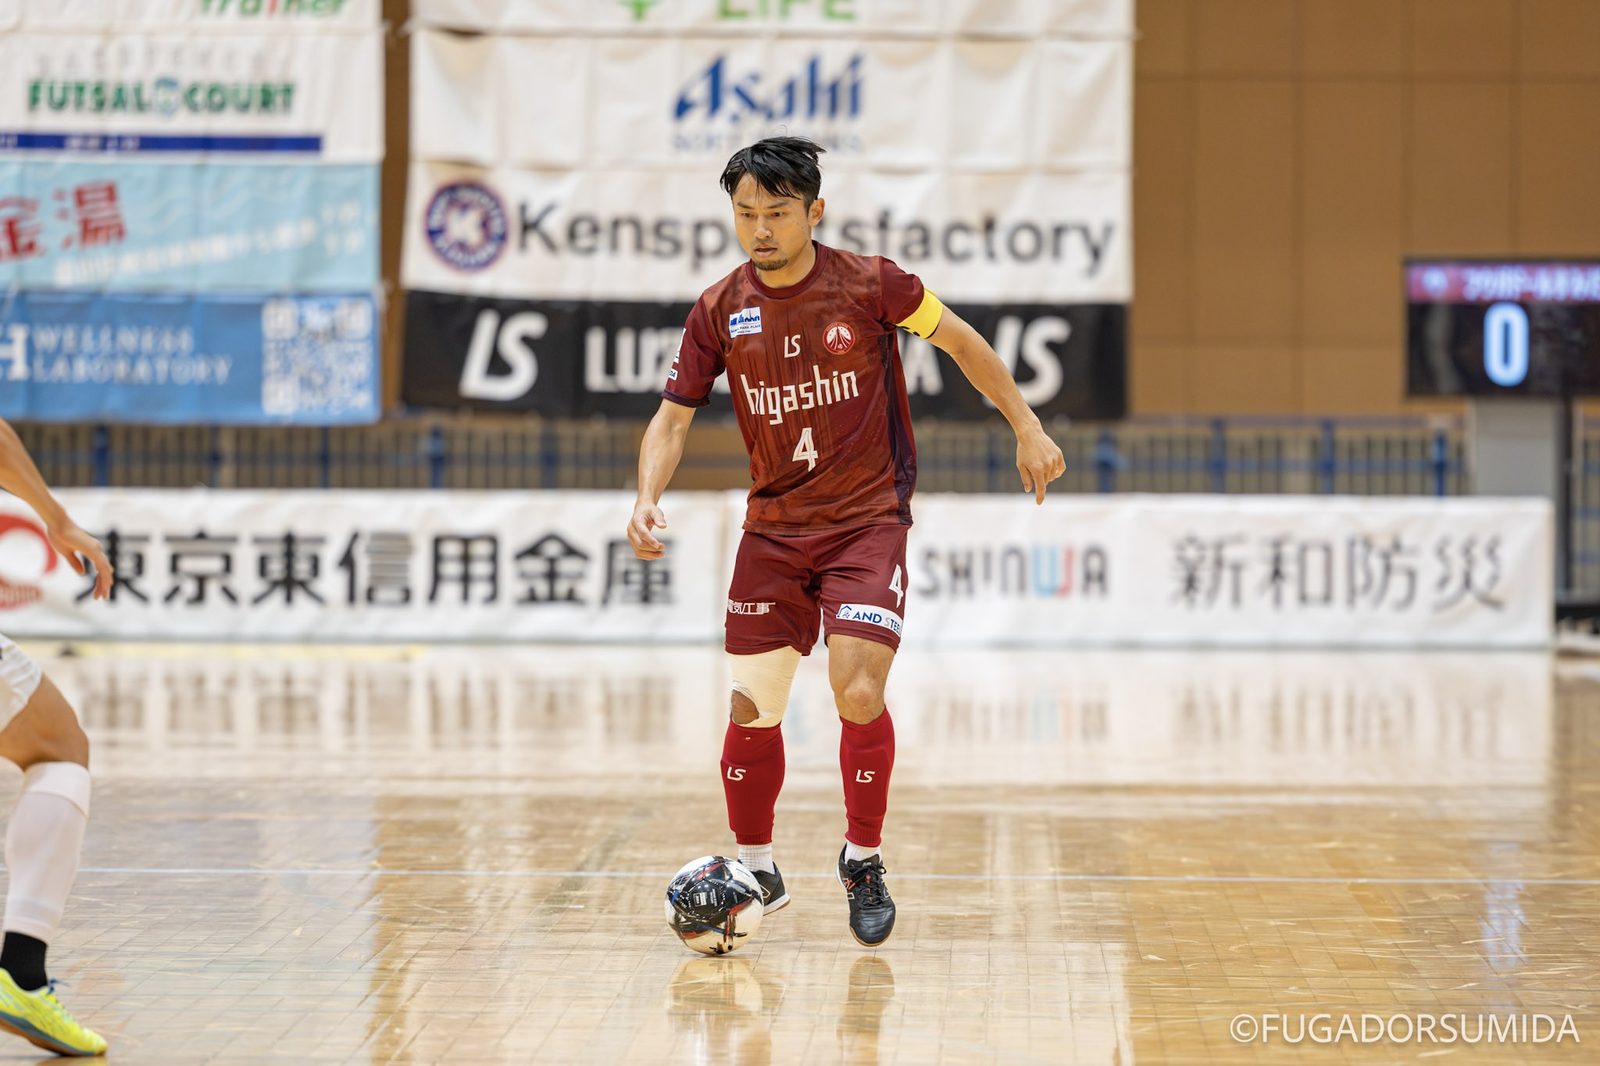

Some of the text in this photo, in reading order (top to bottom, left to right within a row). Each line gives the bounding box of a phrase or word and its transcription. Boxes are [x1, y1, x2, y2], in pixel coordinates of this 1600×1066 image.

[28, 79, 295, 114] FUTSAL COURT
[672, 54, 863, 120] Asahi
[33, 325, 194, 351] WELLNESS
[458, 308, 549, 401] LS
[784, 335, 801, 358] LS
[1482, 301, 1530, 388] 0
[33, 354, 232, 384] LABORATORY
[740, 365, 860, 426] higashin
[791, 427, 819, 472] 4
[888, 564, 904, 609] 4
[917, 543, 1110, 600] SHINWA
[1170, 532, 1508, 612] 新和防災
[852, 611, 883, 624] AND
[726, 766, 746, 781] LS
[855, 769, 875, 783] LS
